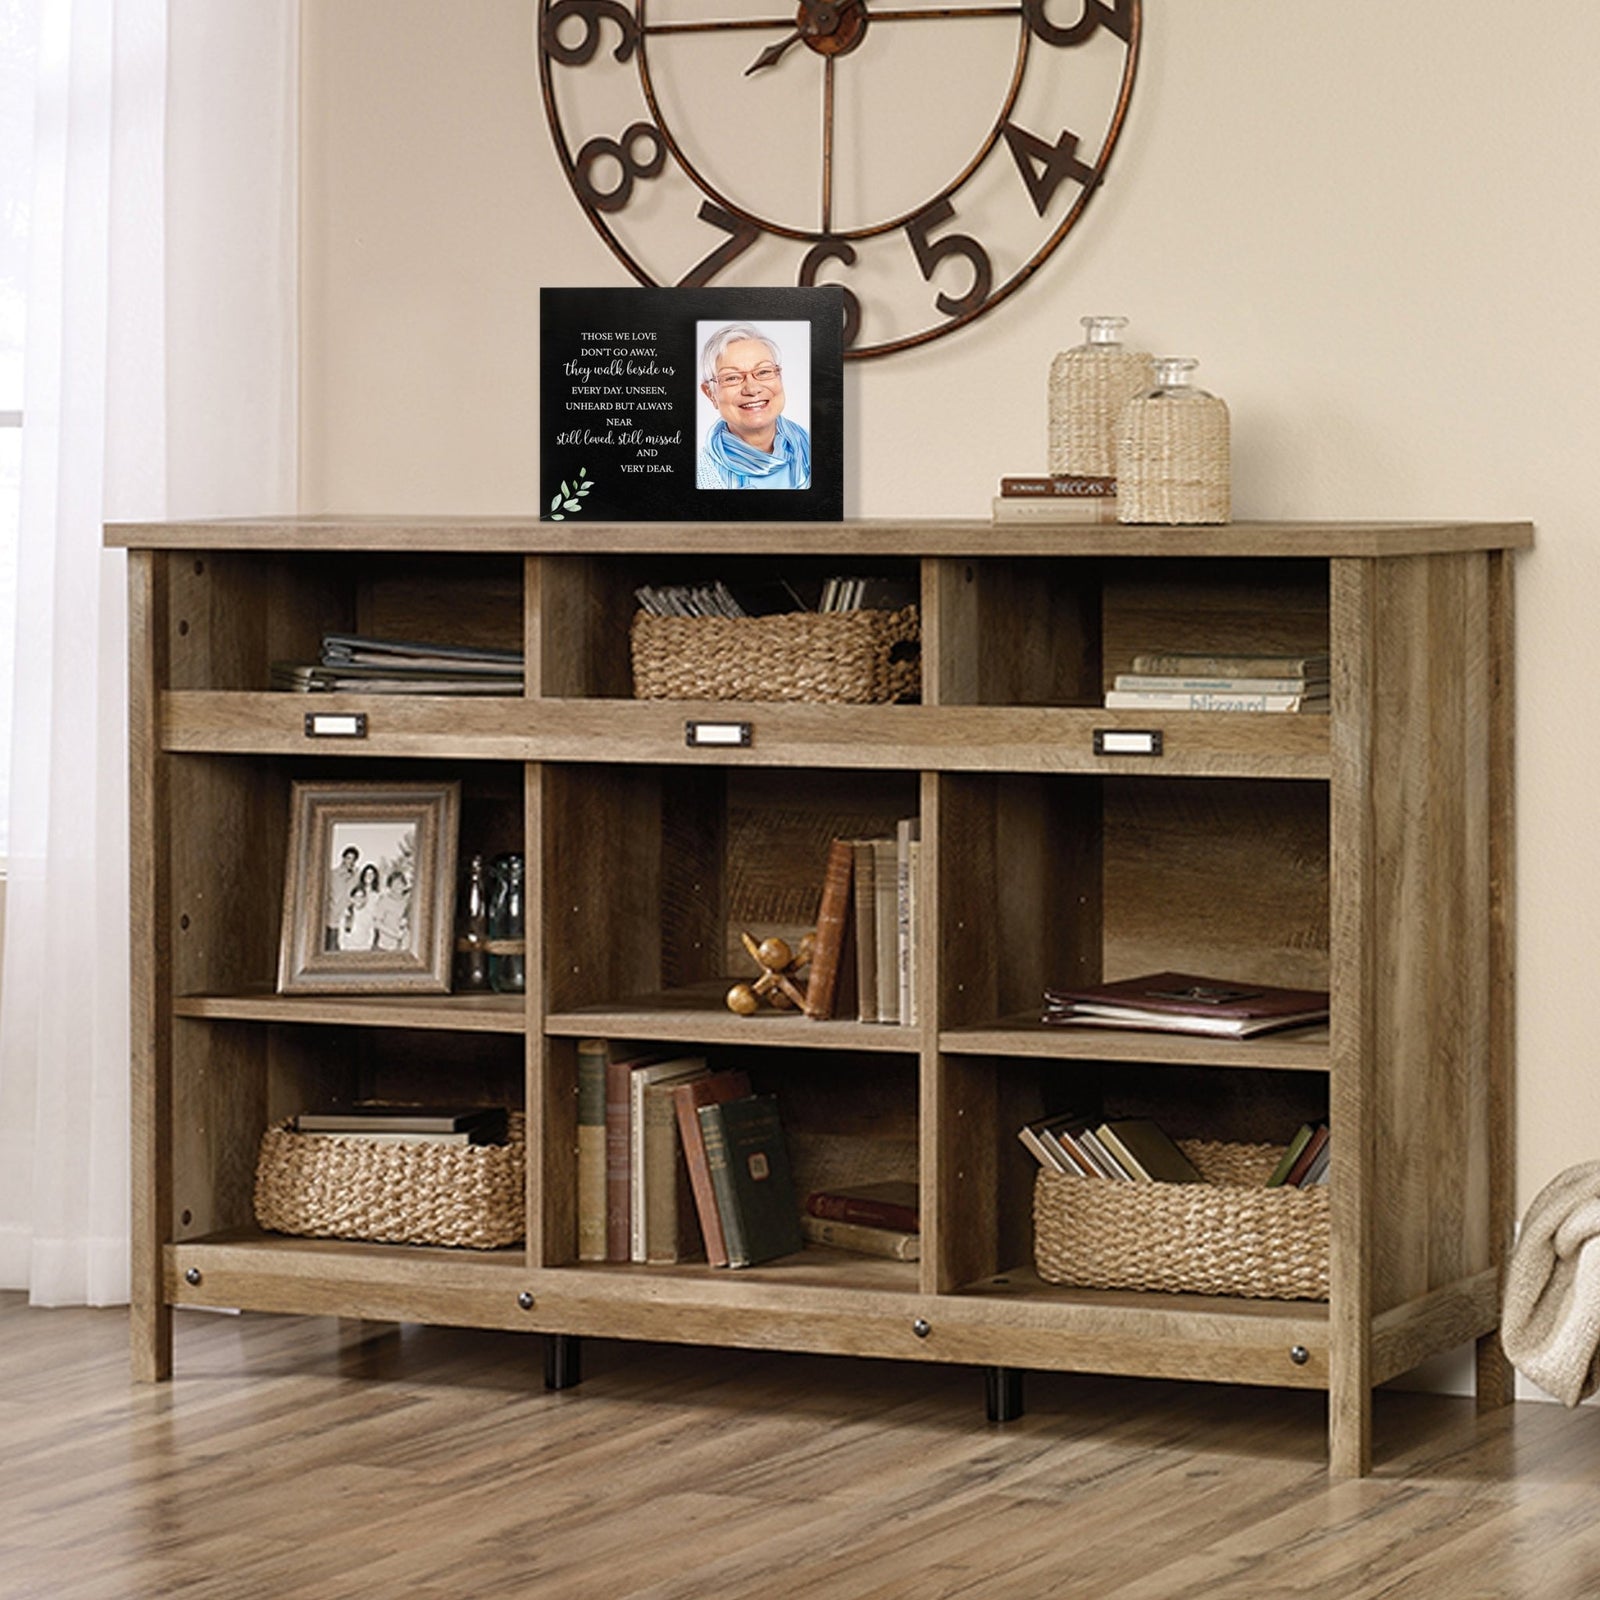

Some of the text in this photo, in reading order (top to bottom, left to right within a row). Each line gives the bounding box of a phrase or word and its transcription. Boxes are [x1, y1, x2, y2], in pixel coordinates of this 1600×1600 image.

[574, 121, 667, 213] 8
[1002, 119, 1104, 218] 4
[903, 199, 993, 318] 5
[580, 332, 658, 341] THOSE WE LOVE
[580, 347, 612, 357] DON'T
[612, 347, 629, 357] GO
[562, 358, 676, 384] they walk beside us
[571, 386, 602, 395] EVERY
[565, 401, 673, 411] UNHEARD BUT ALWAYS
[606, 417, 633, 427] NEAR
[556, 428, 583, 446] still
[617, 428, 644, 446] still
[645, 429, 682, 446] missed
[636, 448, 659, 457] AND
[620, 464, 645, 473] VERY
